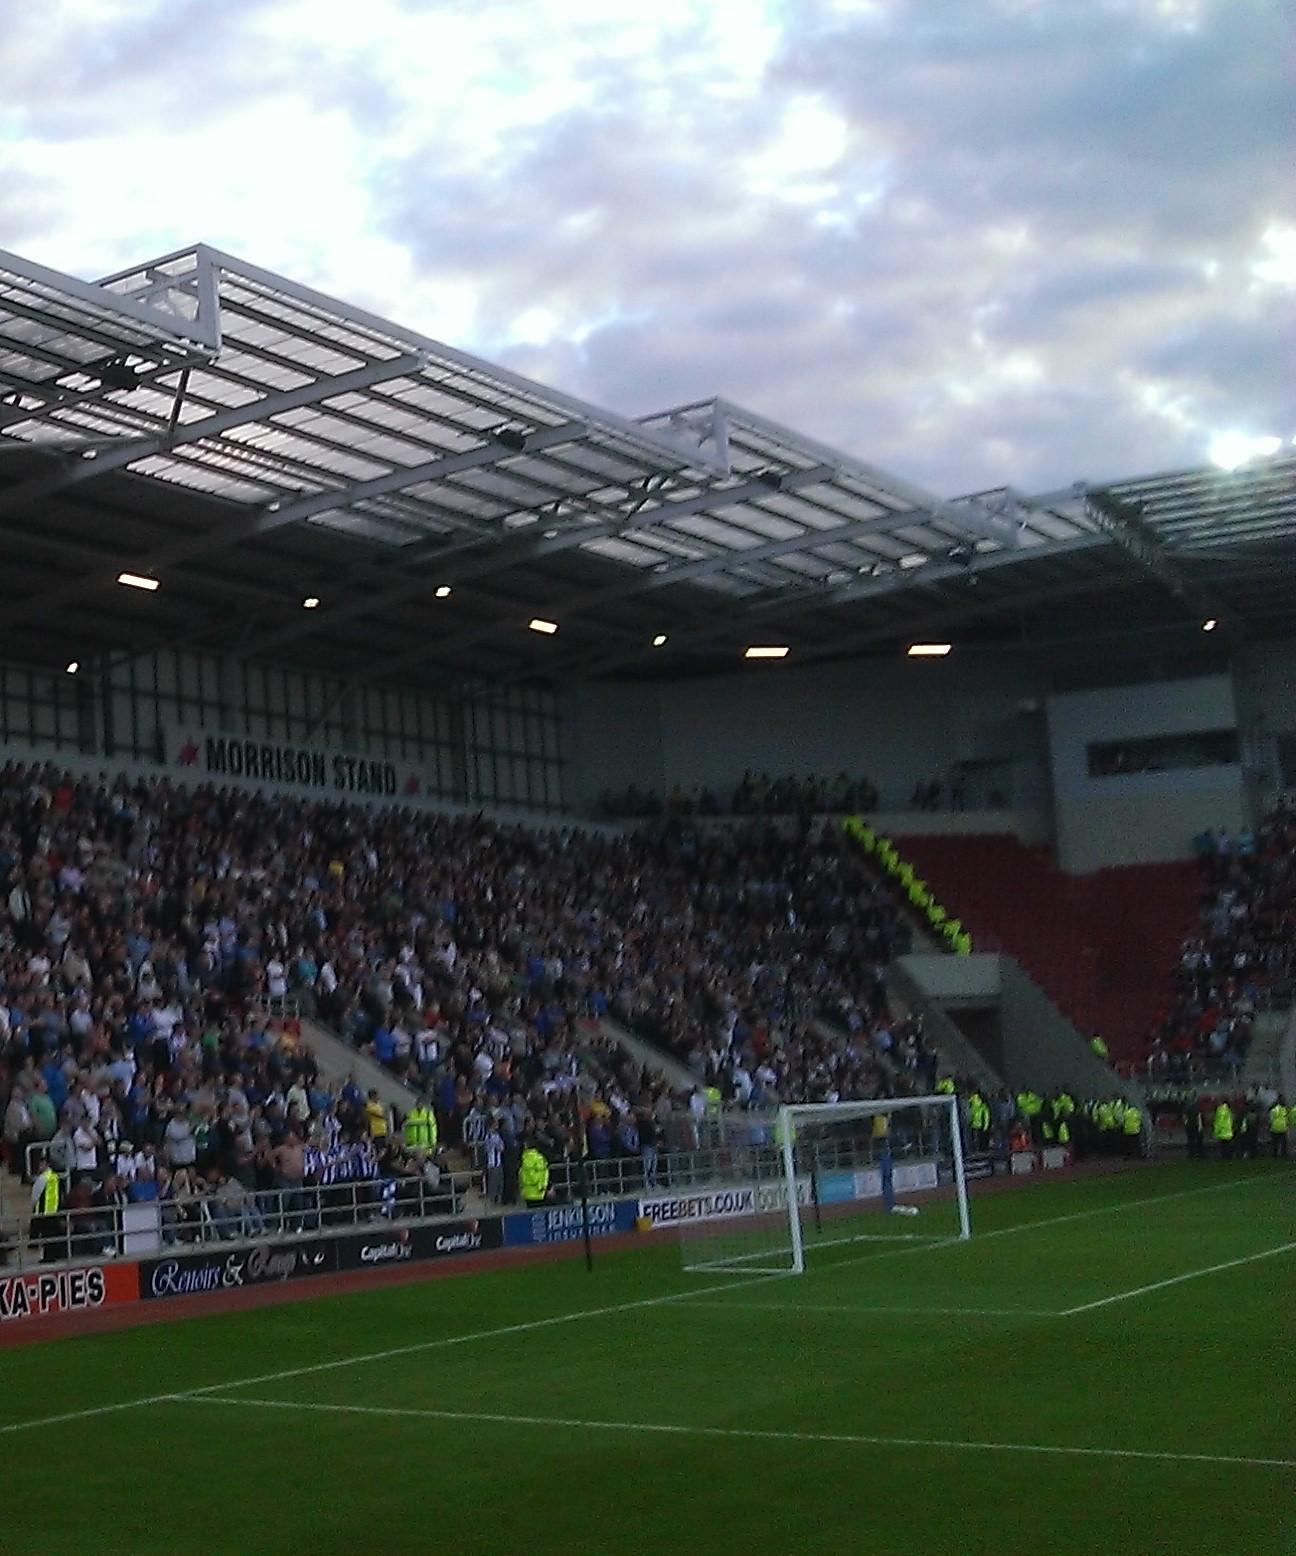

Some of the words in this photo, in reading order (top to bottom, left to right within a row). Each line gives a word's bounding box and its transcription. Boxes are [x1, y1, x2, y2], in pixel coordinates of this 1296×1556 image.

[207, 736, 325, 787] MORRISON
[332, 754, 396, 795] STAND
[222, 1254, 244, 1287] &
